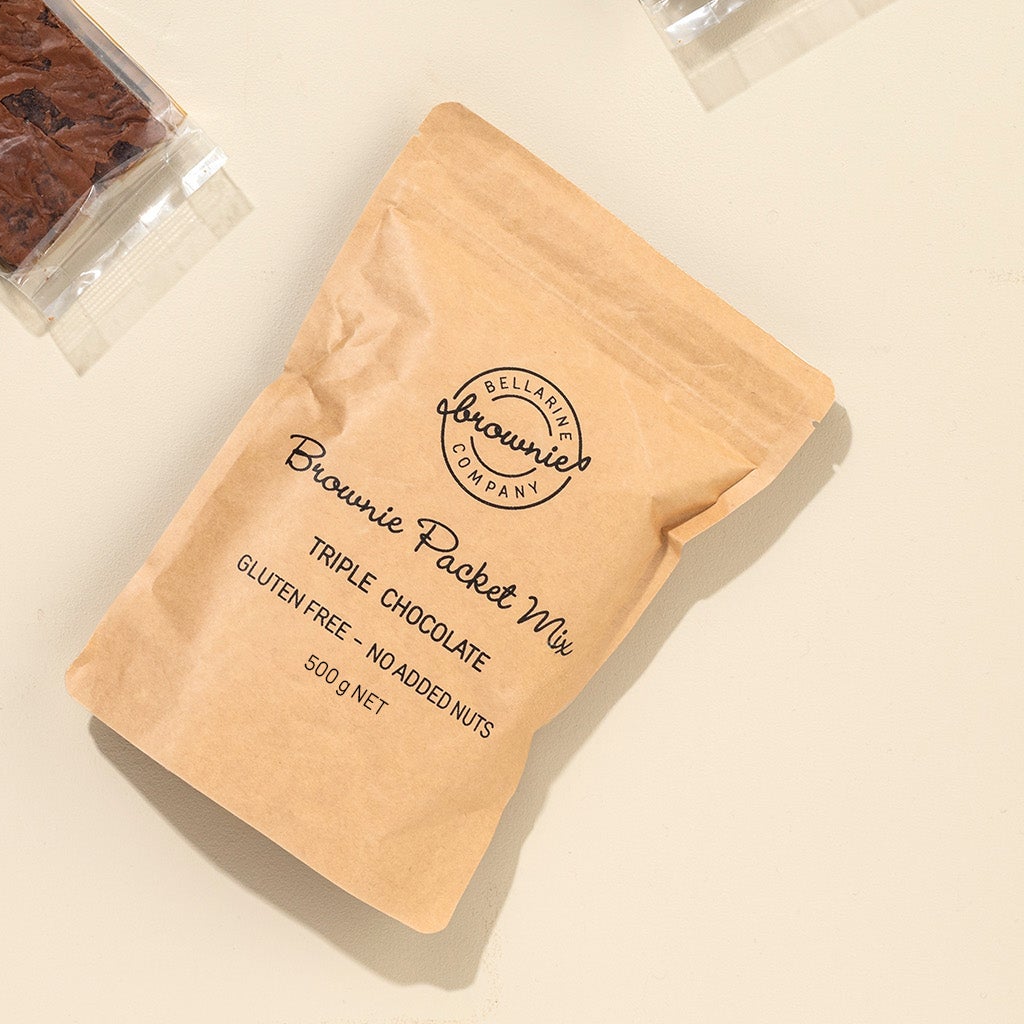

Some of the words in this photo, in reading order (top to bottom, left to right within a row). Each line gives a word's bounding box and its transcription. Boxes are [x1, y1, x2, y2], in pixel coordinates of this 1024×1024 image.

[447, 393, 578, 472] brownie
[484, 376, 572, 442] BELLARINE
[452, 443, 538, 498] COMPANY
[285, 433, 404, 534] Brownie
[414, 517, 518, 609] Packet
[516, 596, 574, 657] Mix
[309, 536, 377, 594] TRIPLE
[380, 588, 492, 673] CHOCOLATE
[236, 554, 306, 609] GLUTEN
[303, 600, 352, 641] FREE
[366, 643, 394, 671] NO
[392, 663, 452, 710] ADDED
[449, 701, 495, 739] NUTS
[350, 684, 389, 715] NET
